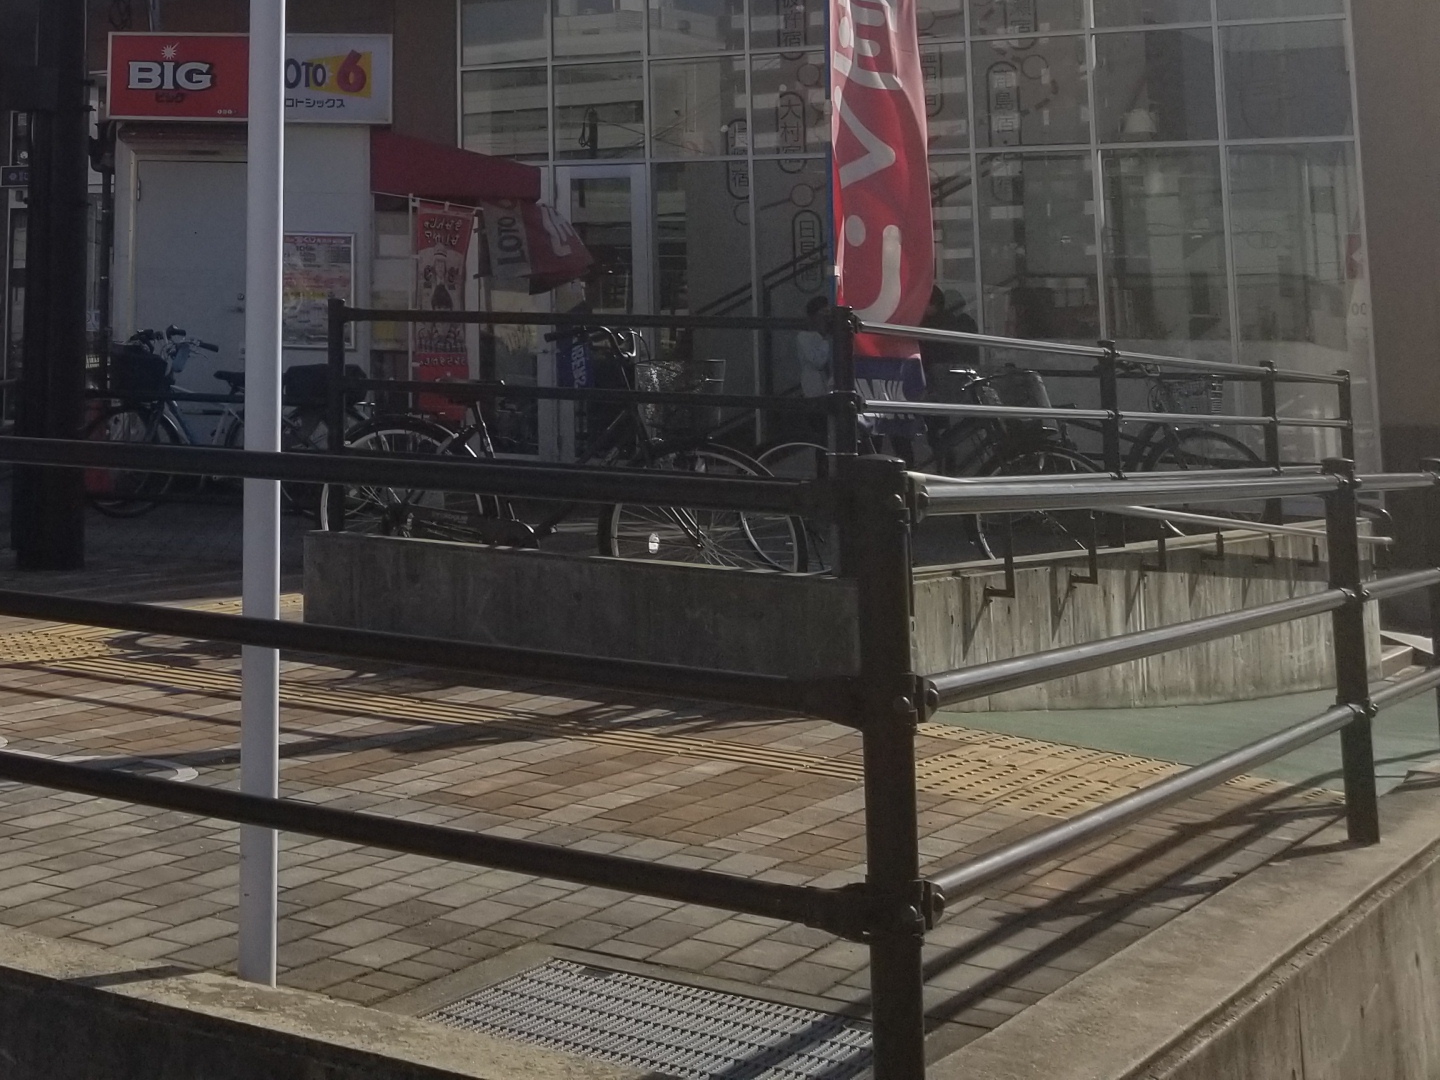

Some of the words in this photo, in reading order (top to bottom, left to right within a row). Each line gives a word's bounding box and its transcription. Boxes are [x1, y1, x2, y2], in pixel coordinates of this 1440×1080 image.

[127, 61, 213, 91] BIG
[284, 57, 327, 89] OTO
[336, 49, 367, 93] 6
